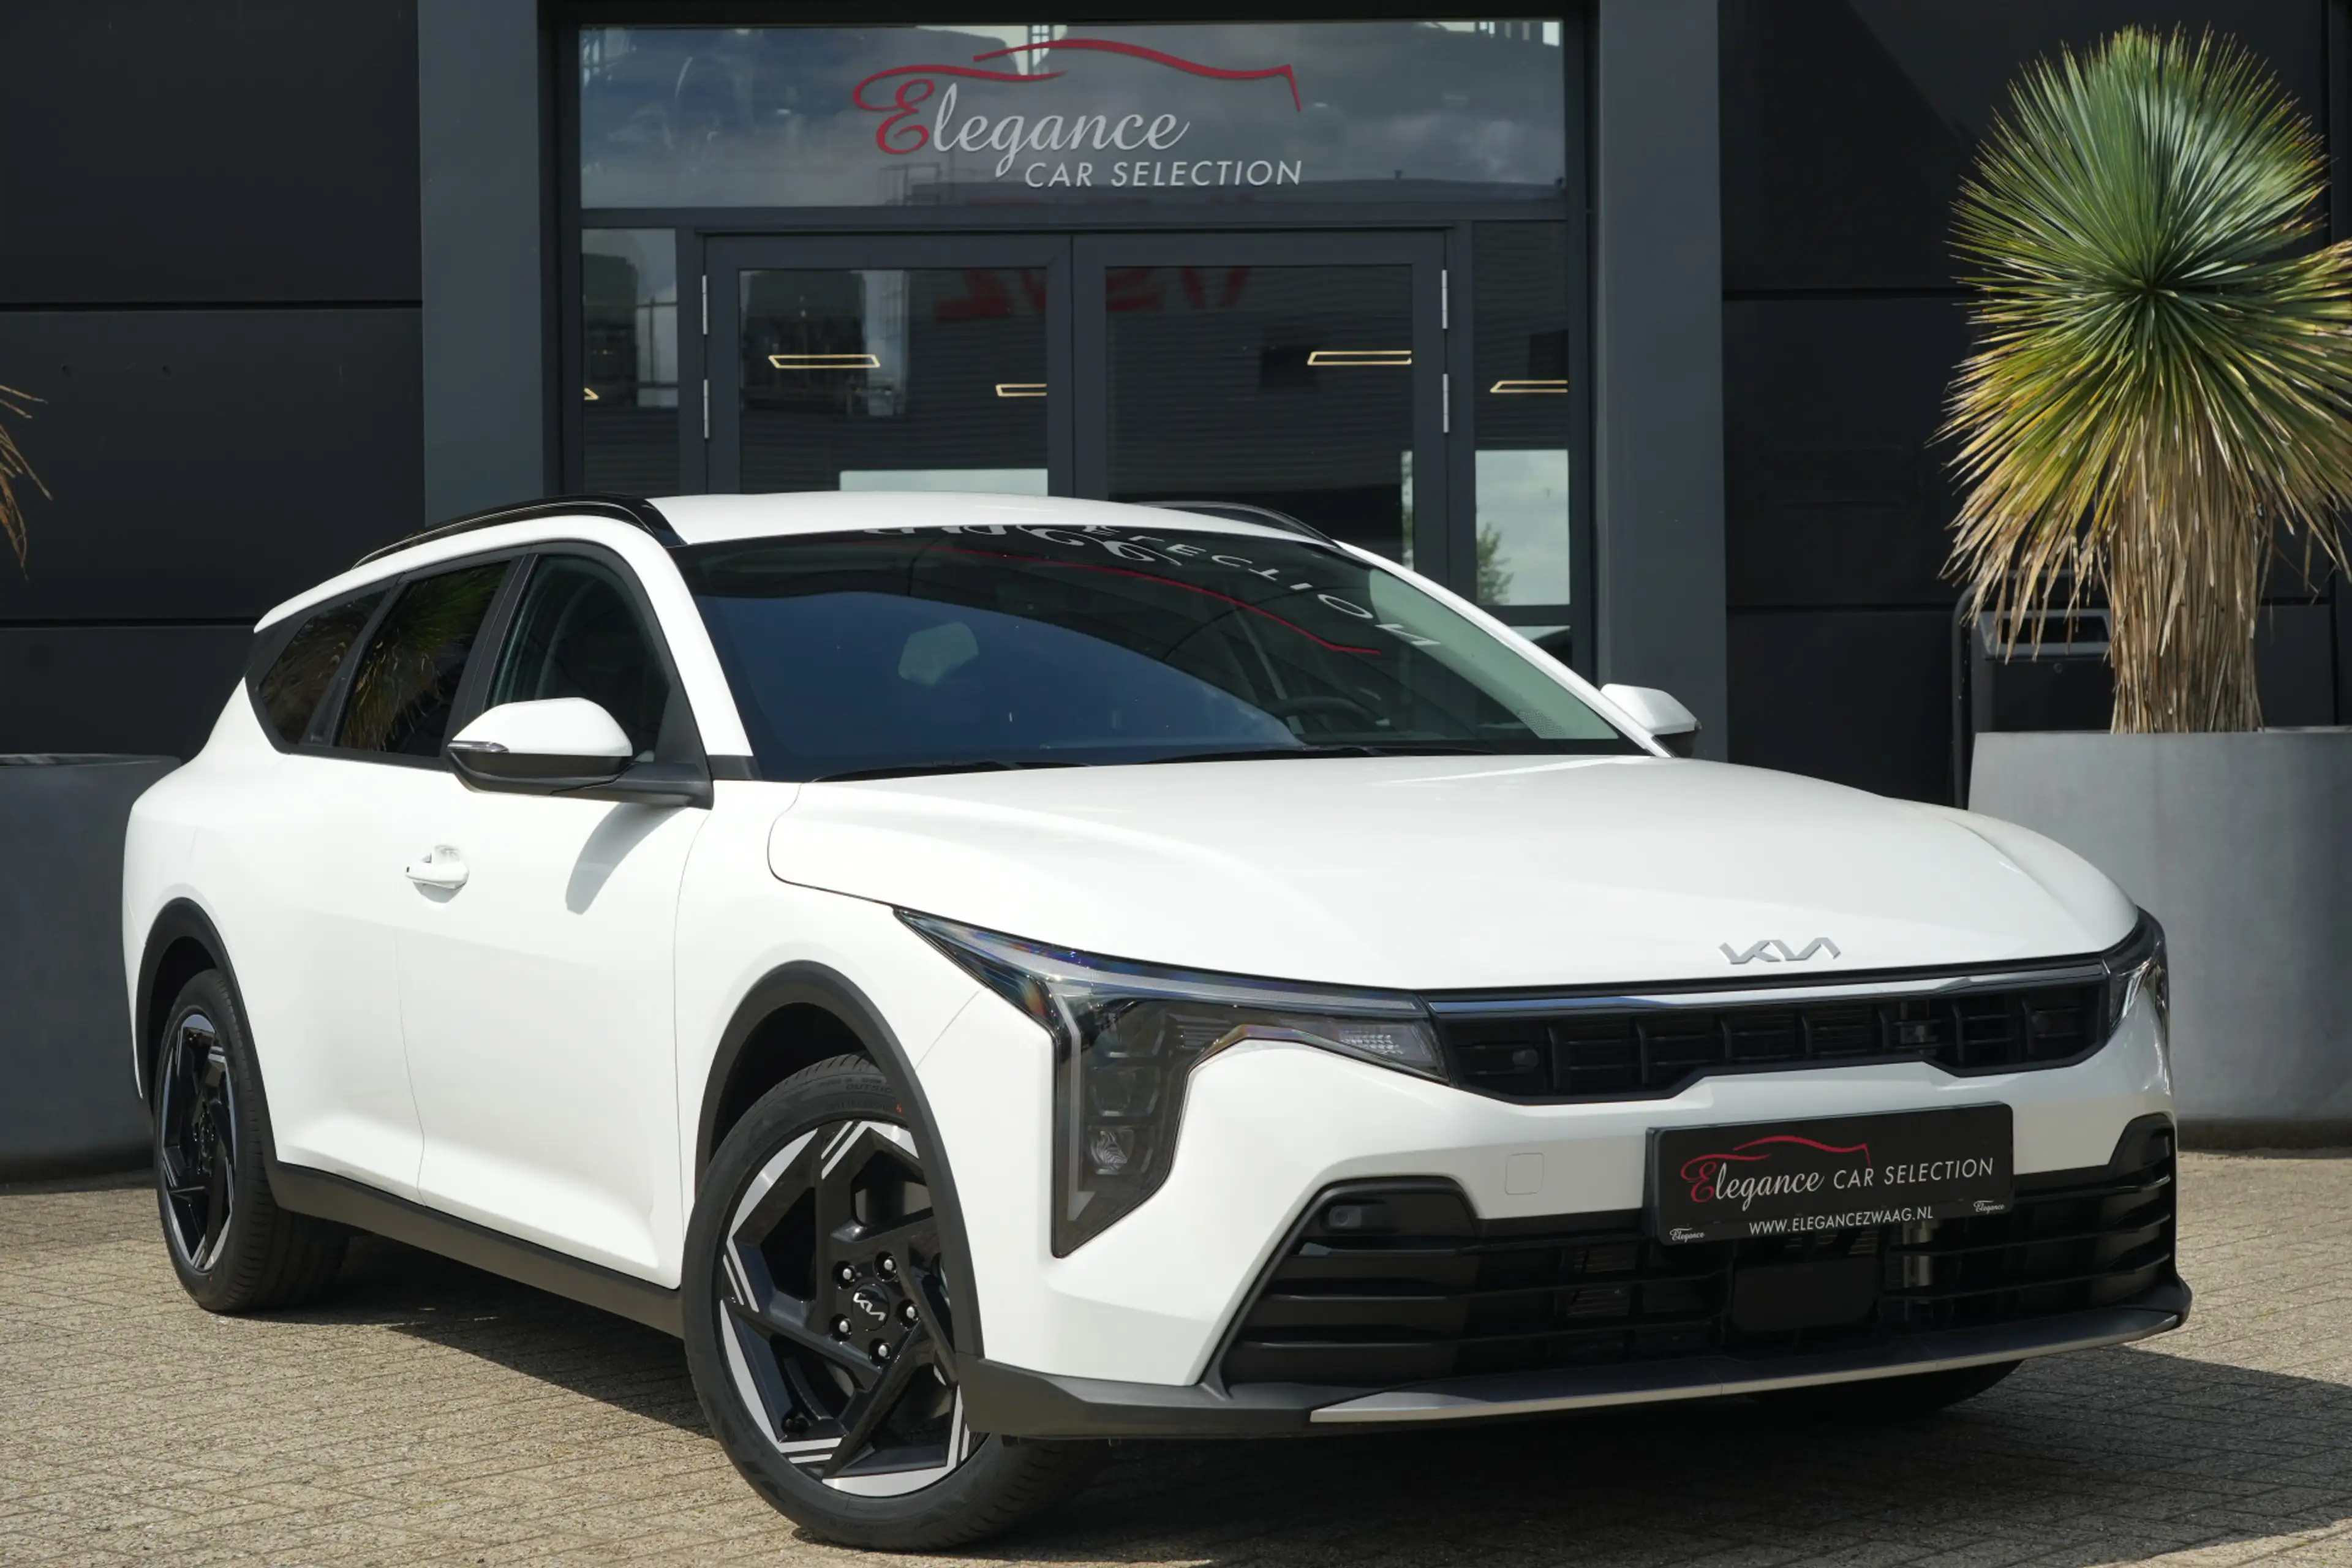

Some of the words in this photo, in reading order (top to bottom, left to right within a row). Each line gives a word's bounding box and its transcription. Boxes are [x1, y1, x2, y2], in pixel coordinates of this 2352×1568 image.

[853, 77, 1189, 178] Elegance
[1025, 161, 1093, 187] CAR
[1110, 160, 1302, 187] SELECTION
[1718, 937, 1841, 965] KIA
[1681, 1161, 1825, 1212] Elegance
[1833, 1167, 1874, 1189] CAR
[1883, 1158, 1994, 1186] SELECTION
[1749, 1205, 1933, 1235] WWW.ELEGANCEZWAAG.NL
